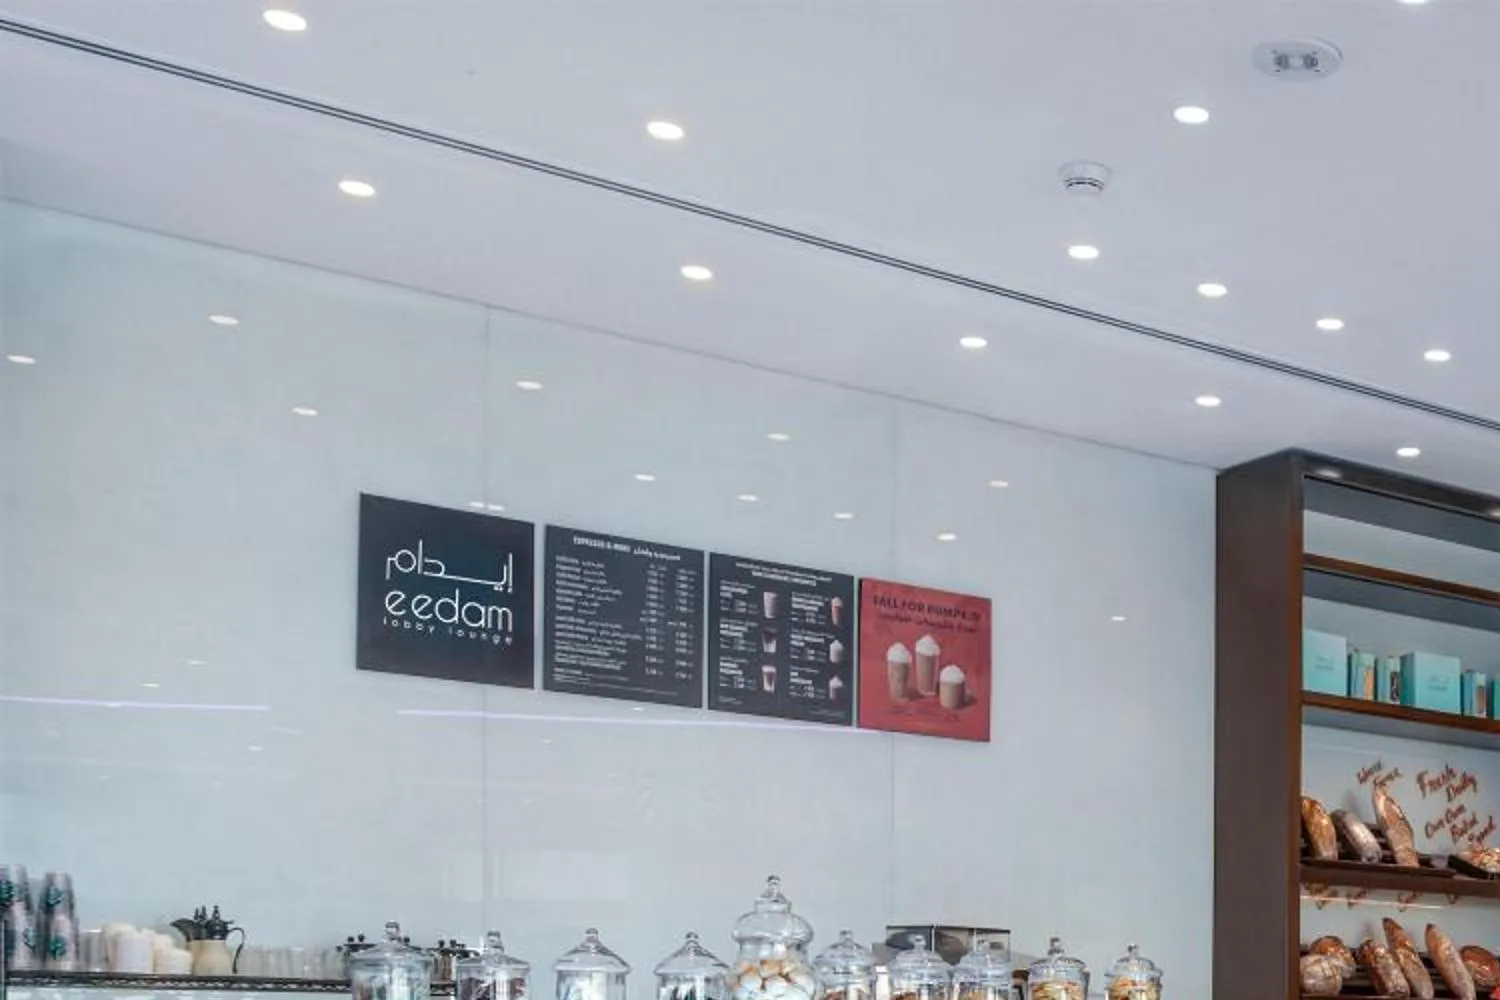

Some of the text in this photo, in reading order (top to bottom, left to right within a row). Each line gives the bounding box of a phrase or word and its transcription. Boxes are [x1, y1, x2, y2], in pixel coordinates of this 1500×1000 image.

[385, 588, 513, 632] eedam
[873, 595, 898, 609] FALL
[900, 600, 925, 612] FOR
[383, 616, 513, 646] lobby lounge
